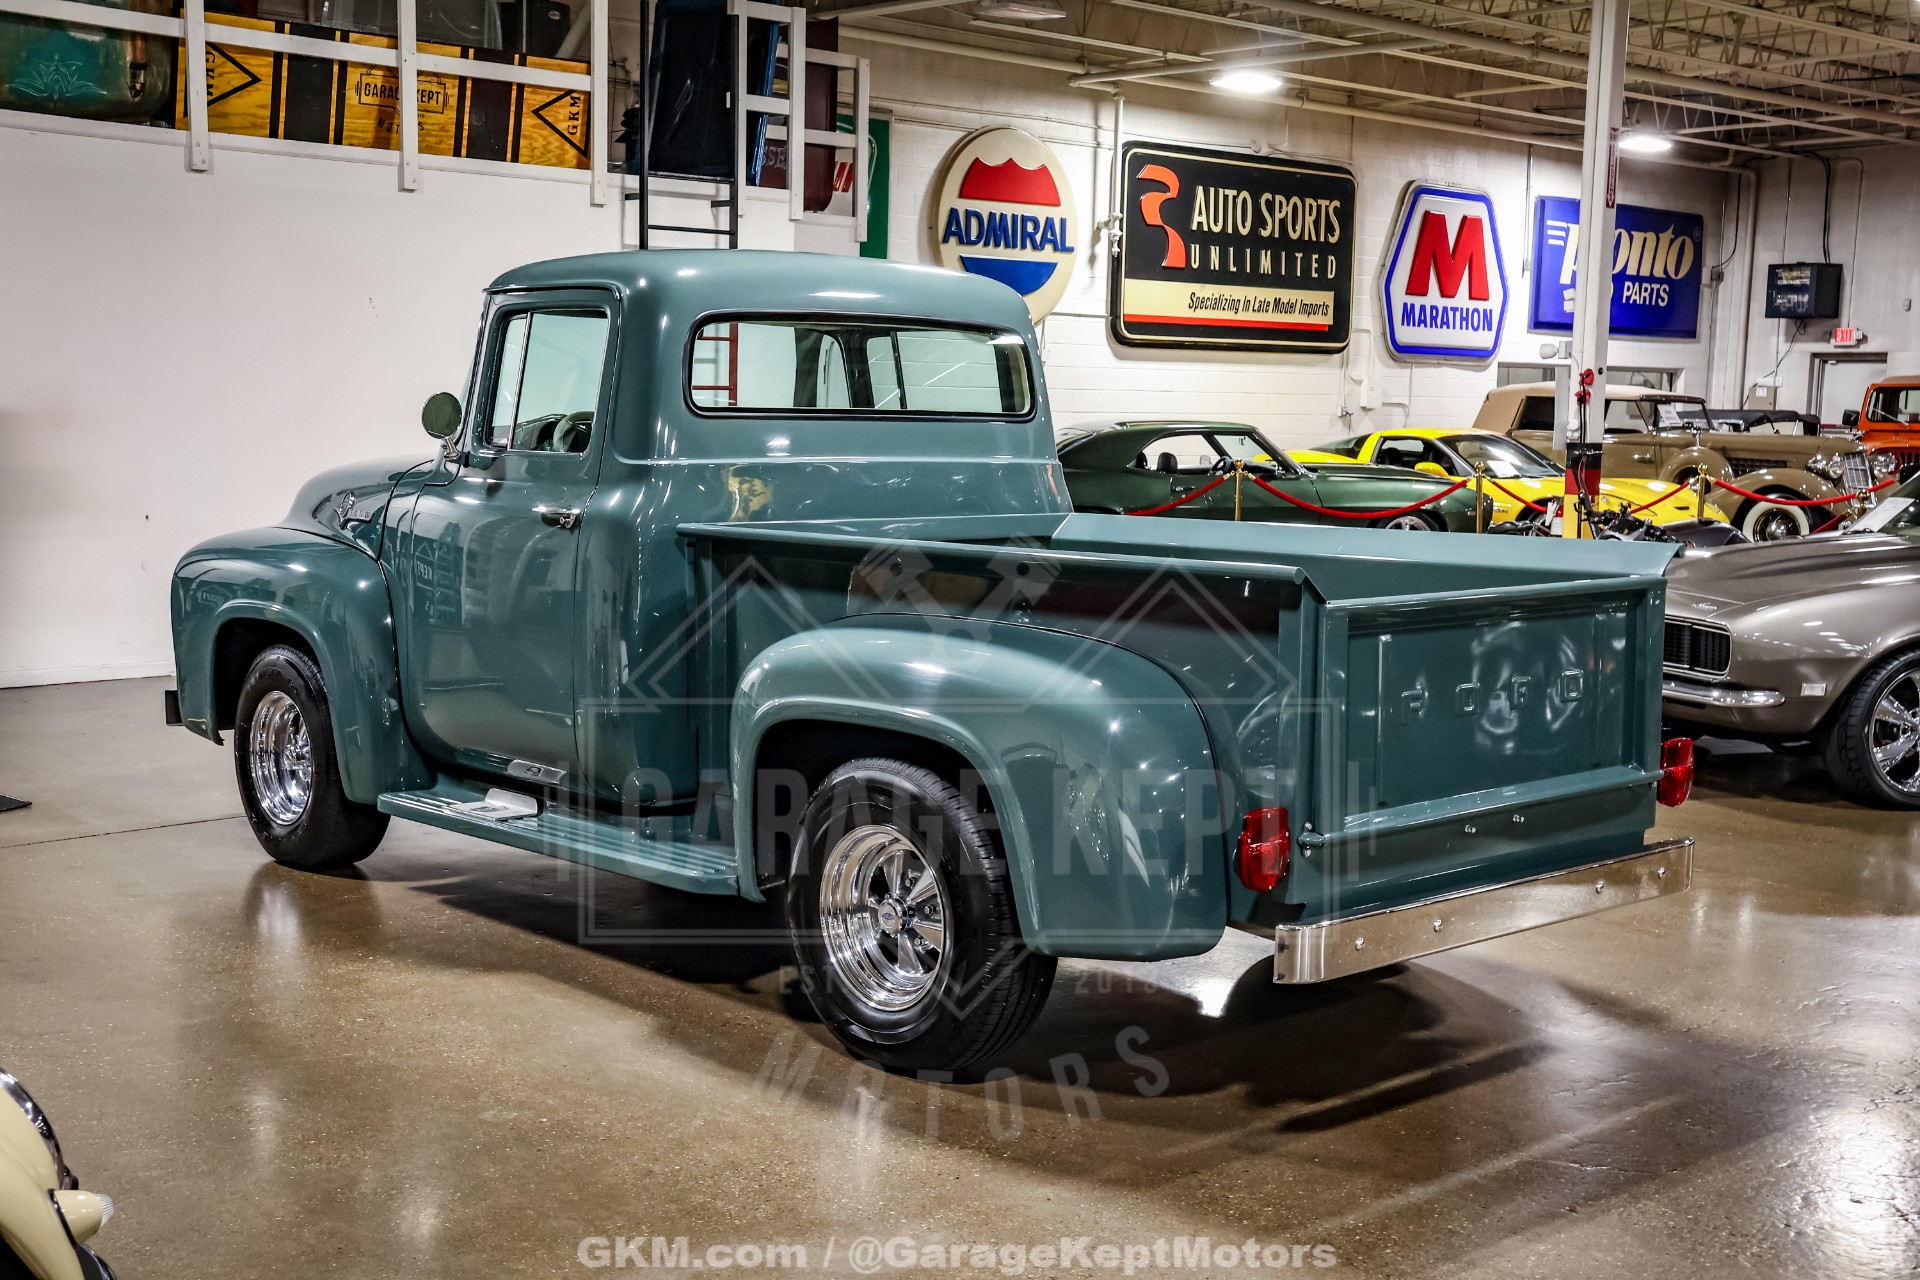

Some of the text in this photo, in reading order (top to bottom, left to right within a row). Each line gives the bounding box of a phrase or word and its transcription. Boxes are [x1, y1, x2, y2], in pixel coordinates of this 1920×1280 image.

[376, 117, 425, 135] MOTS
[567, 95, 581, 136] GKM
[942, 206, 1075, 253] ADMIRAL
[1190, 185, 1341, 244] AUTO SPORTS
[1189, 243, 1337, 280] UNLIMITED
[1405, 210, 1490, 301] M
[1188, 291, 1330, 316] Specializing In Late Model Imports
[1622, 280, 1670, 307] PARTS
[1401, 301, 1493, 332] MARATHON
[1834, 327, 1855, 343] EXIT
[1401, 668, 1584, 726] FORD
